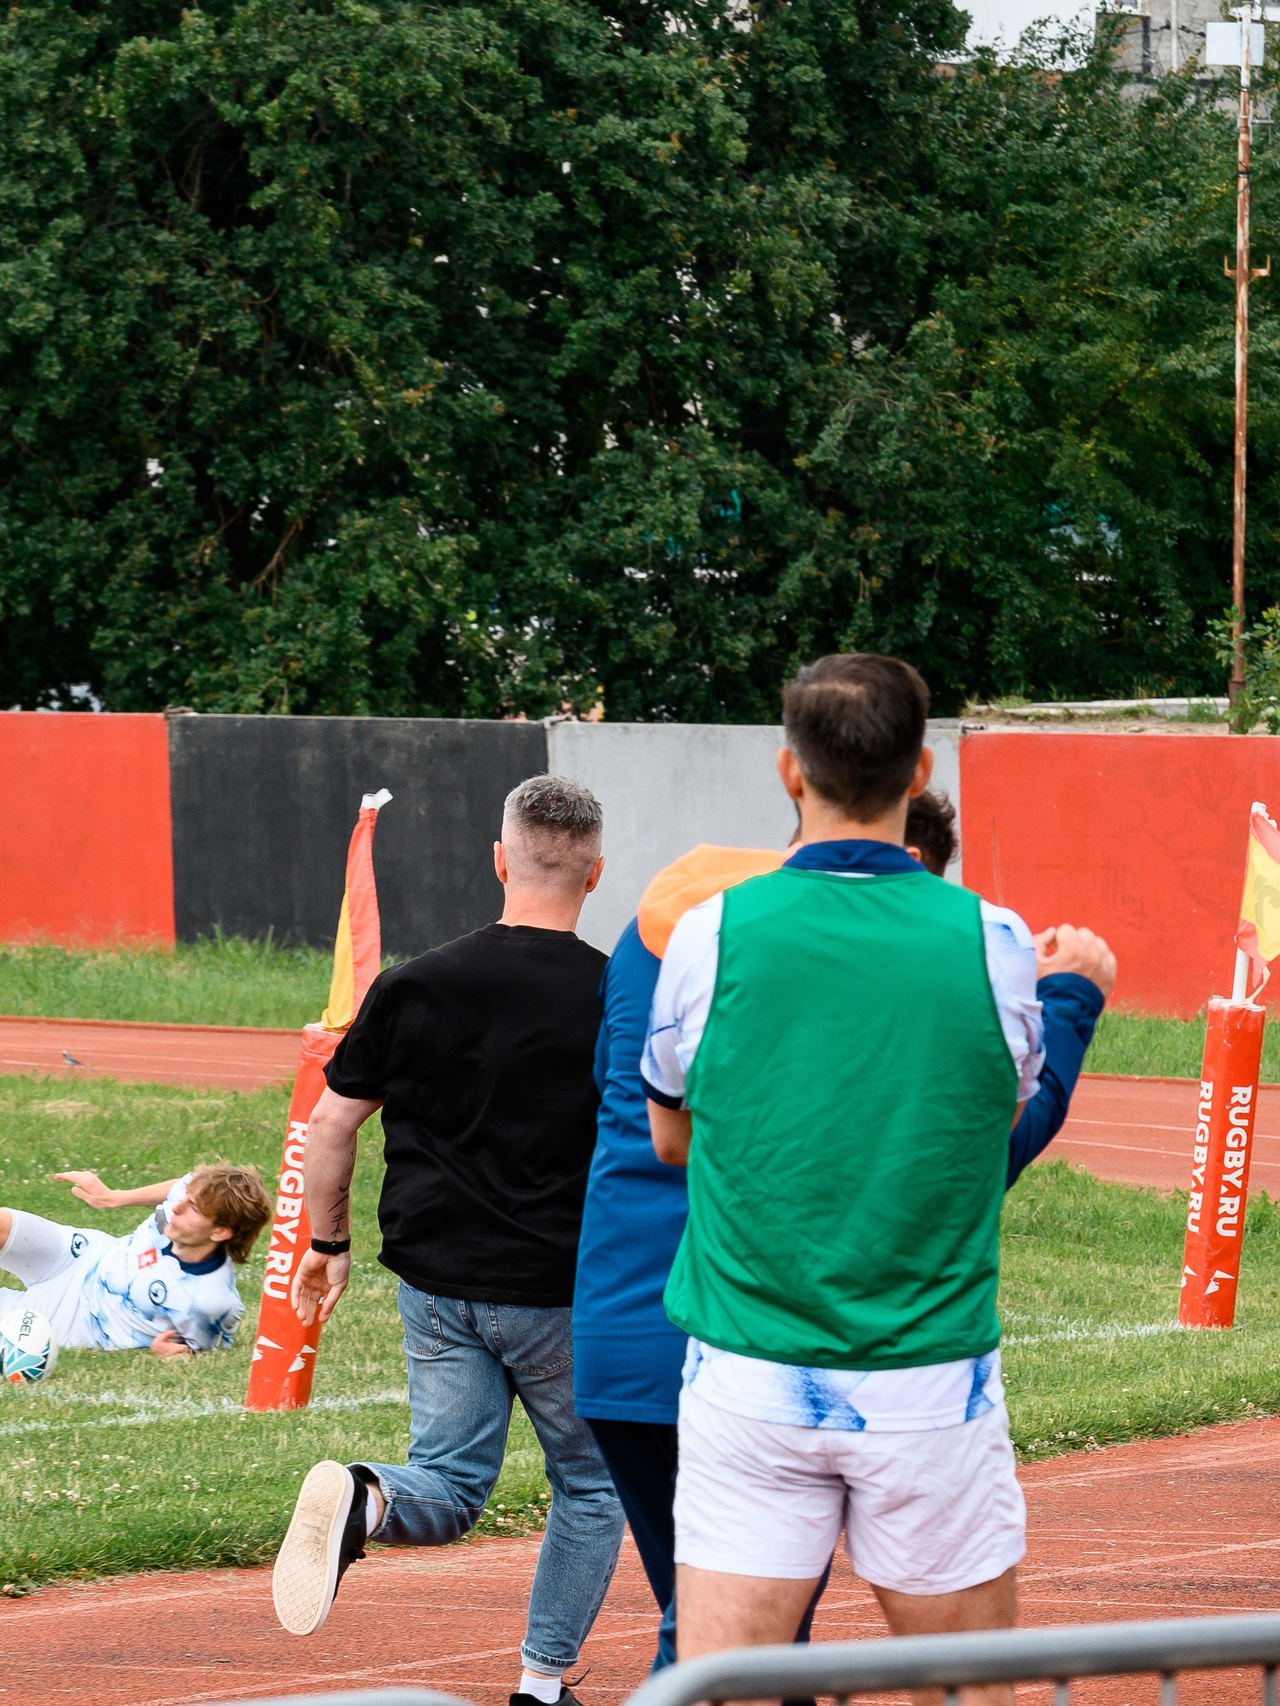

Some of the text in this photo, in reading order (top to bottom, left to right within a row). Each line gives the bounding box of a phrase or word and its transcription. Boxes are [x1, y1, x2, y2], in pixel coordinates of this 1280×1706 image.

[264, 1120, 308, 1299] RUGBY.RU
[1187, 1081, 1213, 1233] RUGBY.RU
[1216, 1085, 1253, 1237] RUGBY.RU
